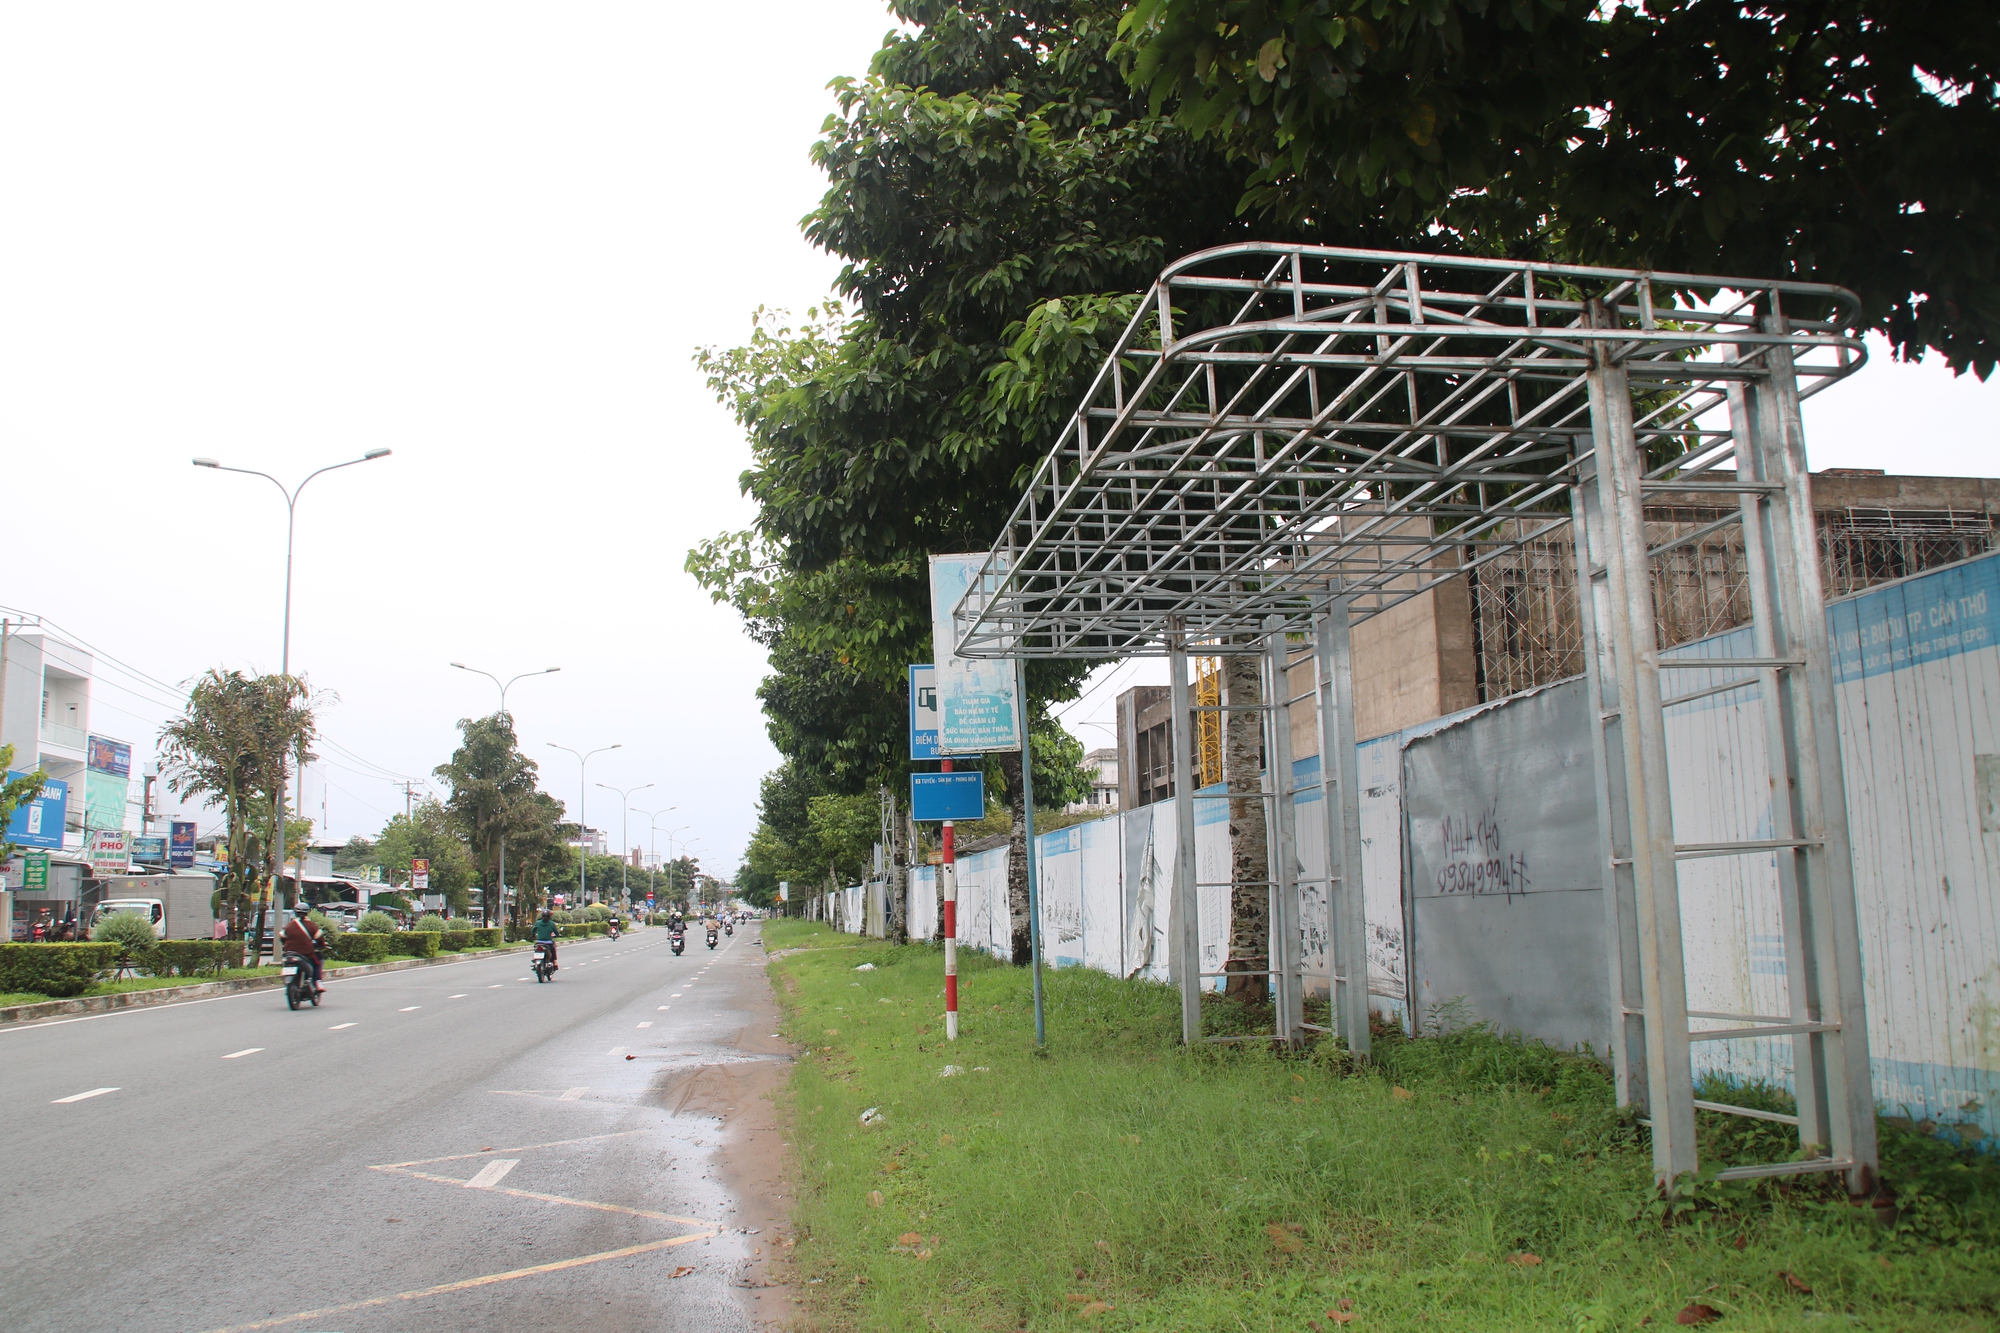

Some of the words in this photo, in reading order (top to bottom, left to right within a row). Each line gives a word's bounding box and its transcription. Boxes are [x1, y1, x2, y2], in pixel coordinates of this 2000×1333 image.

[1844, 630, 1869, 650] UNG
[1929, 599, 1957, 628] CẦN
[1959, 589, 1988, 618] THƠ
[981, 697, 991, 705] GIA
[991, 705, 999, 714] TẾ
[915, 732, 932, 745] ĐIỂM
